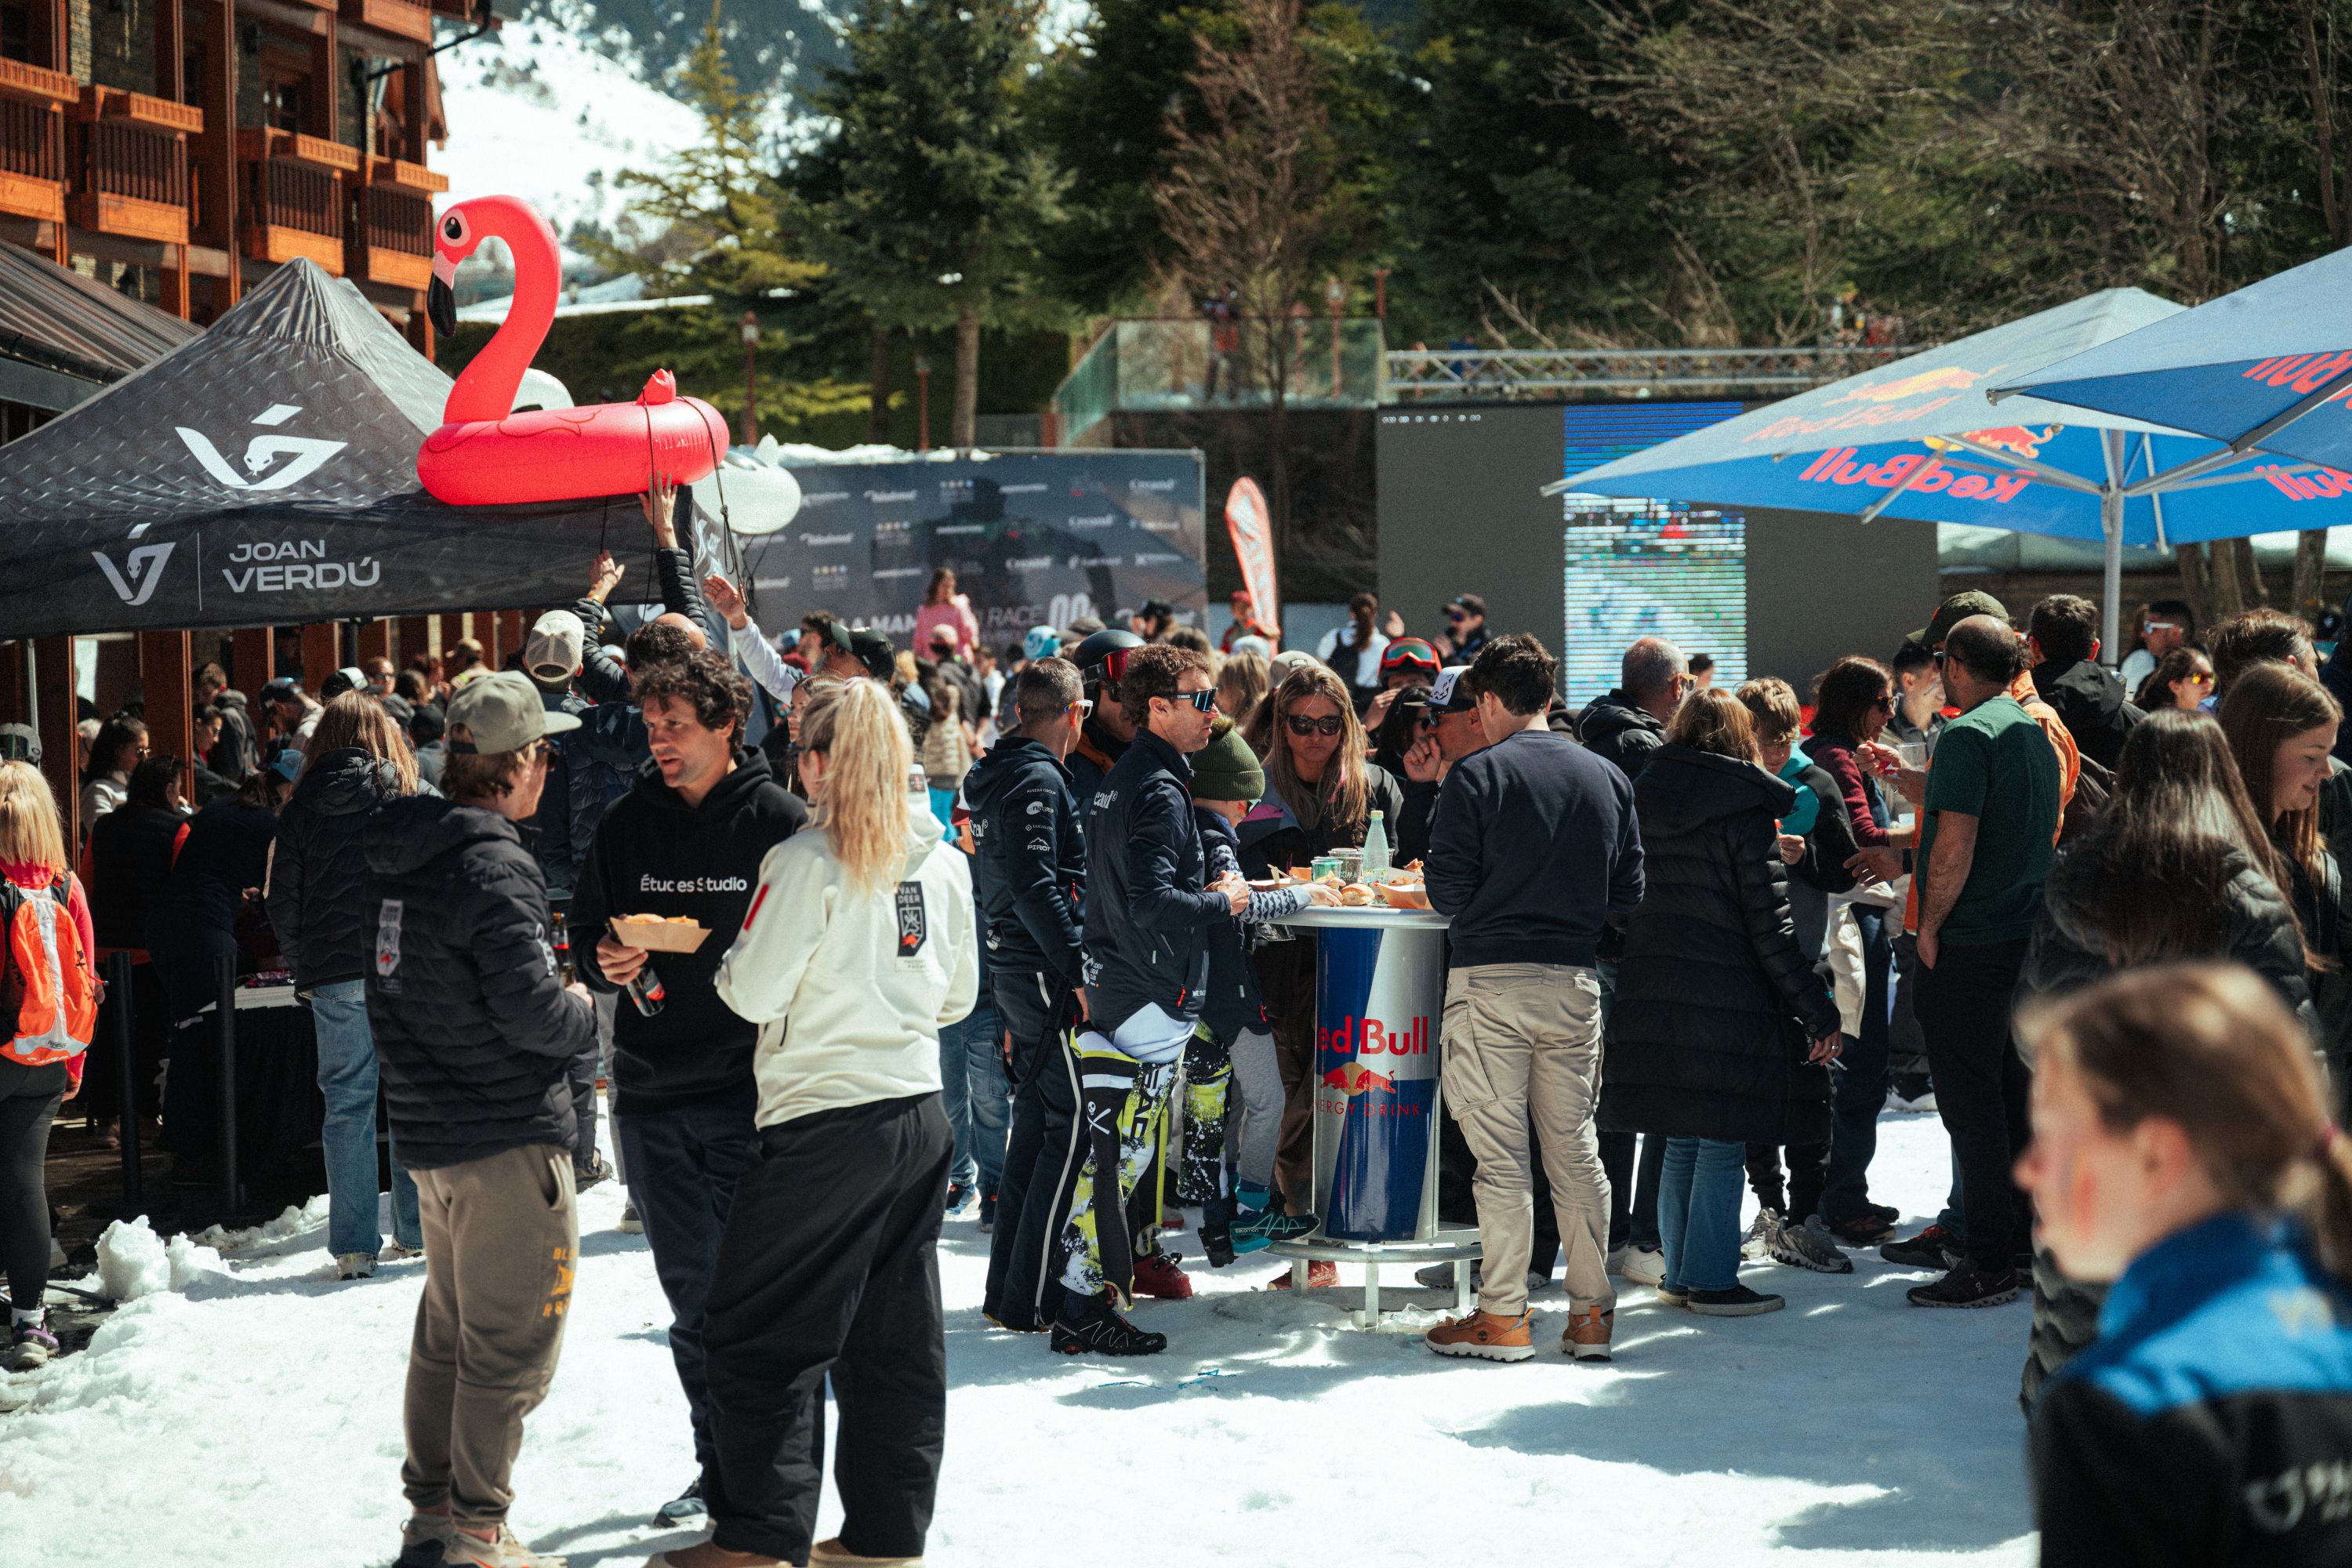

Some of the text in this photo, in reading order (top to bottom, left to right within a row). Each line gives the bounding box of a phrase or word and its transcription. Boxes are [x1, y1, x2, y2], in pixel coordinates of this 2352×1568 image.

[229, 539, 325, 563] JOAN
[222, 557, 380, 593] VERDÚ
[988, 605, 1044, 626] RACE
[898, 895, 921, 904] DEER
[1316, 1015, 1428, 1056] ed Bull
[1315, 1100, 1421, 1117] NERGY DRINK
